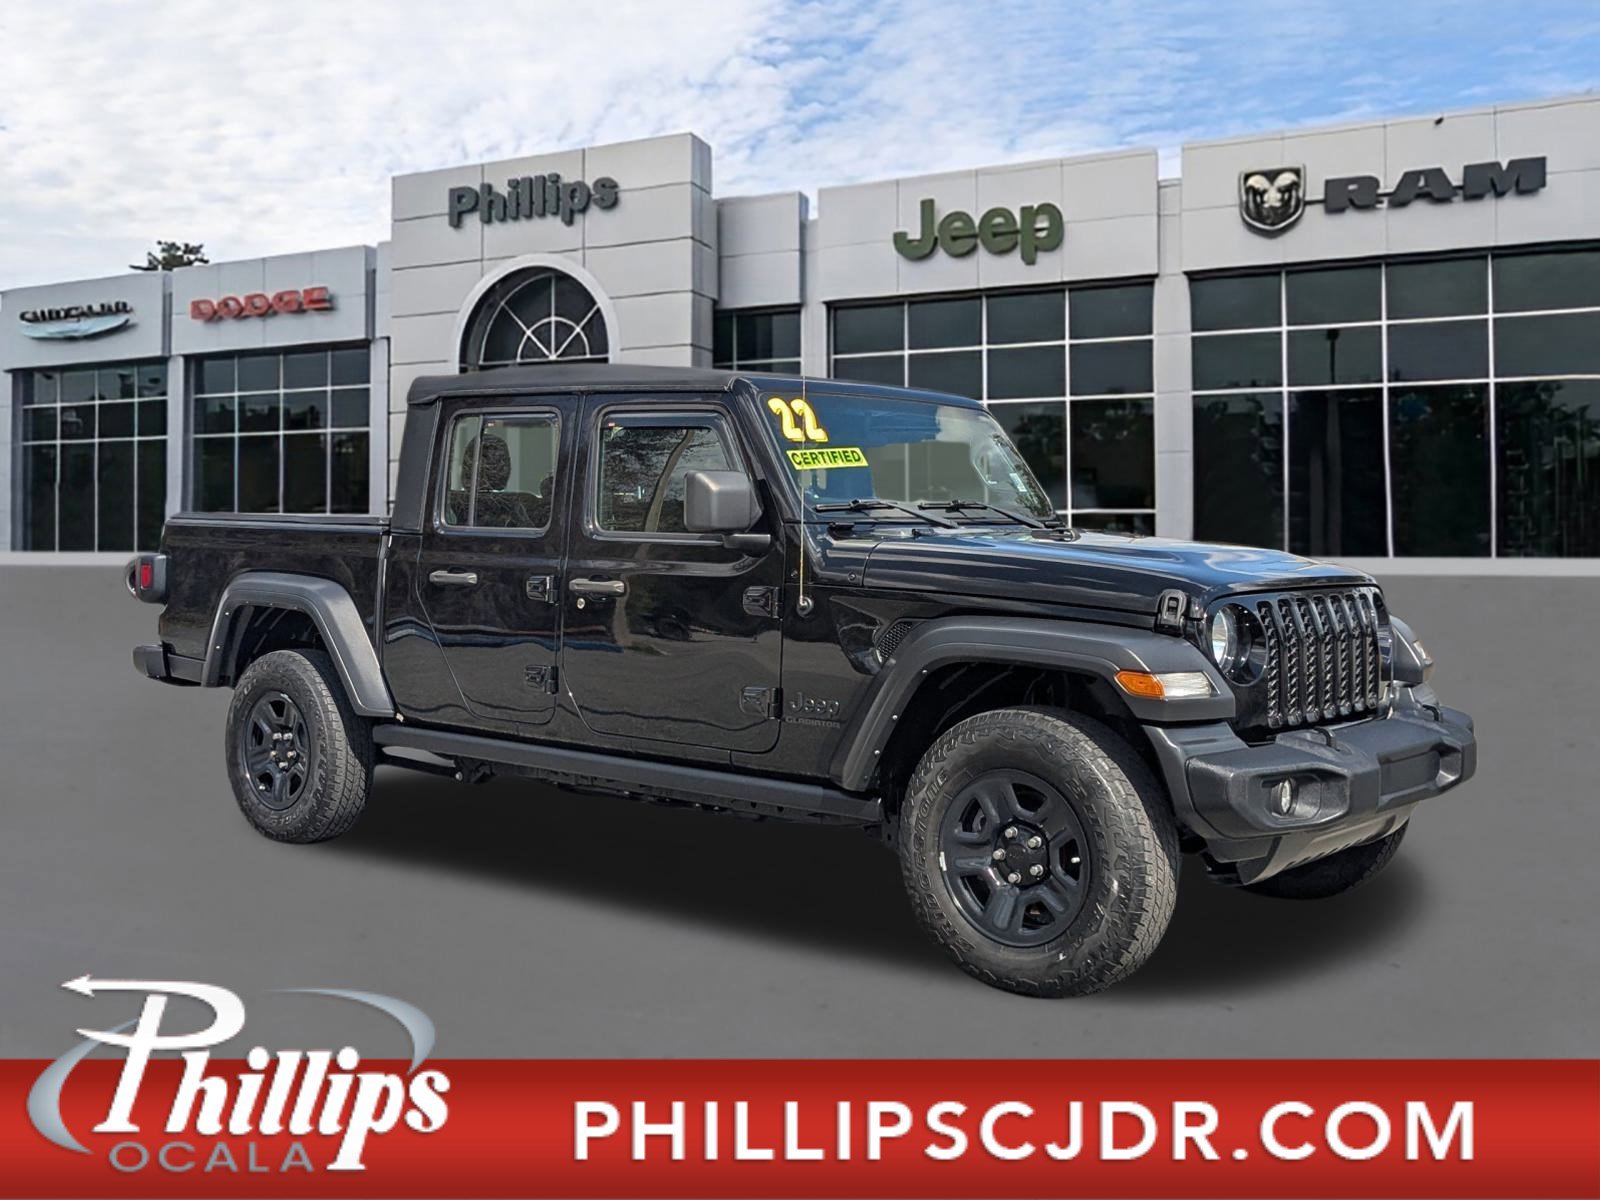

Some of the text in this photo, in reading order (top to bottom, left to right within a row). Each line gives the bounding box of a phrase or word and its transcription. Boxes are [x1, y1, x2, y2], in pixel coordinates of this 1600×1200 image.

[449, 173, 620, 228] Phillips
[1325, 156, 1547, 214] RAM
[893, 198, 1064, 266] Jeep
[189, 286, 334, 322] DODGE
[767, 397, 829, 442] 22
[791, 449, 862, 466] CERTIFIED
[784, 715, 842, 729] GLADIATOR
[789, 691, 841, 720] Jeep
